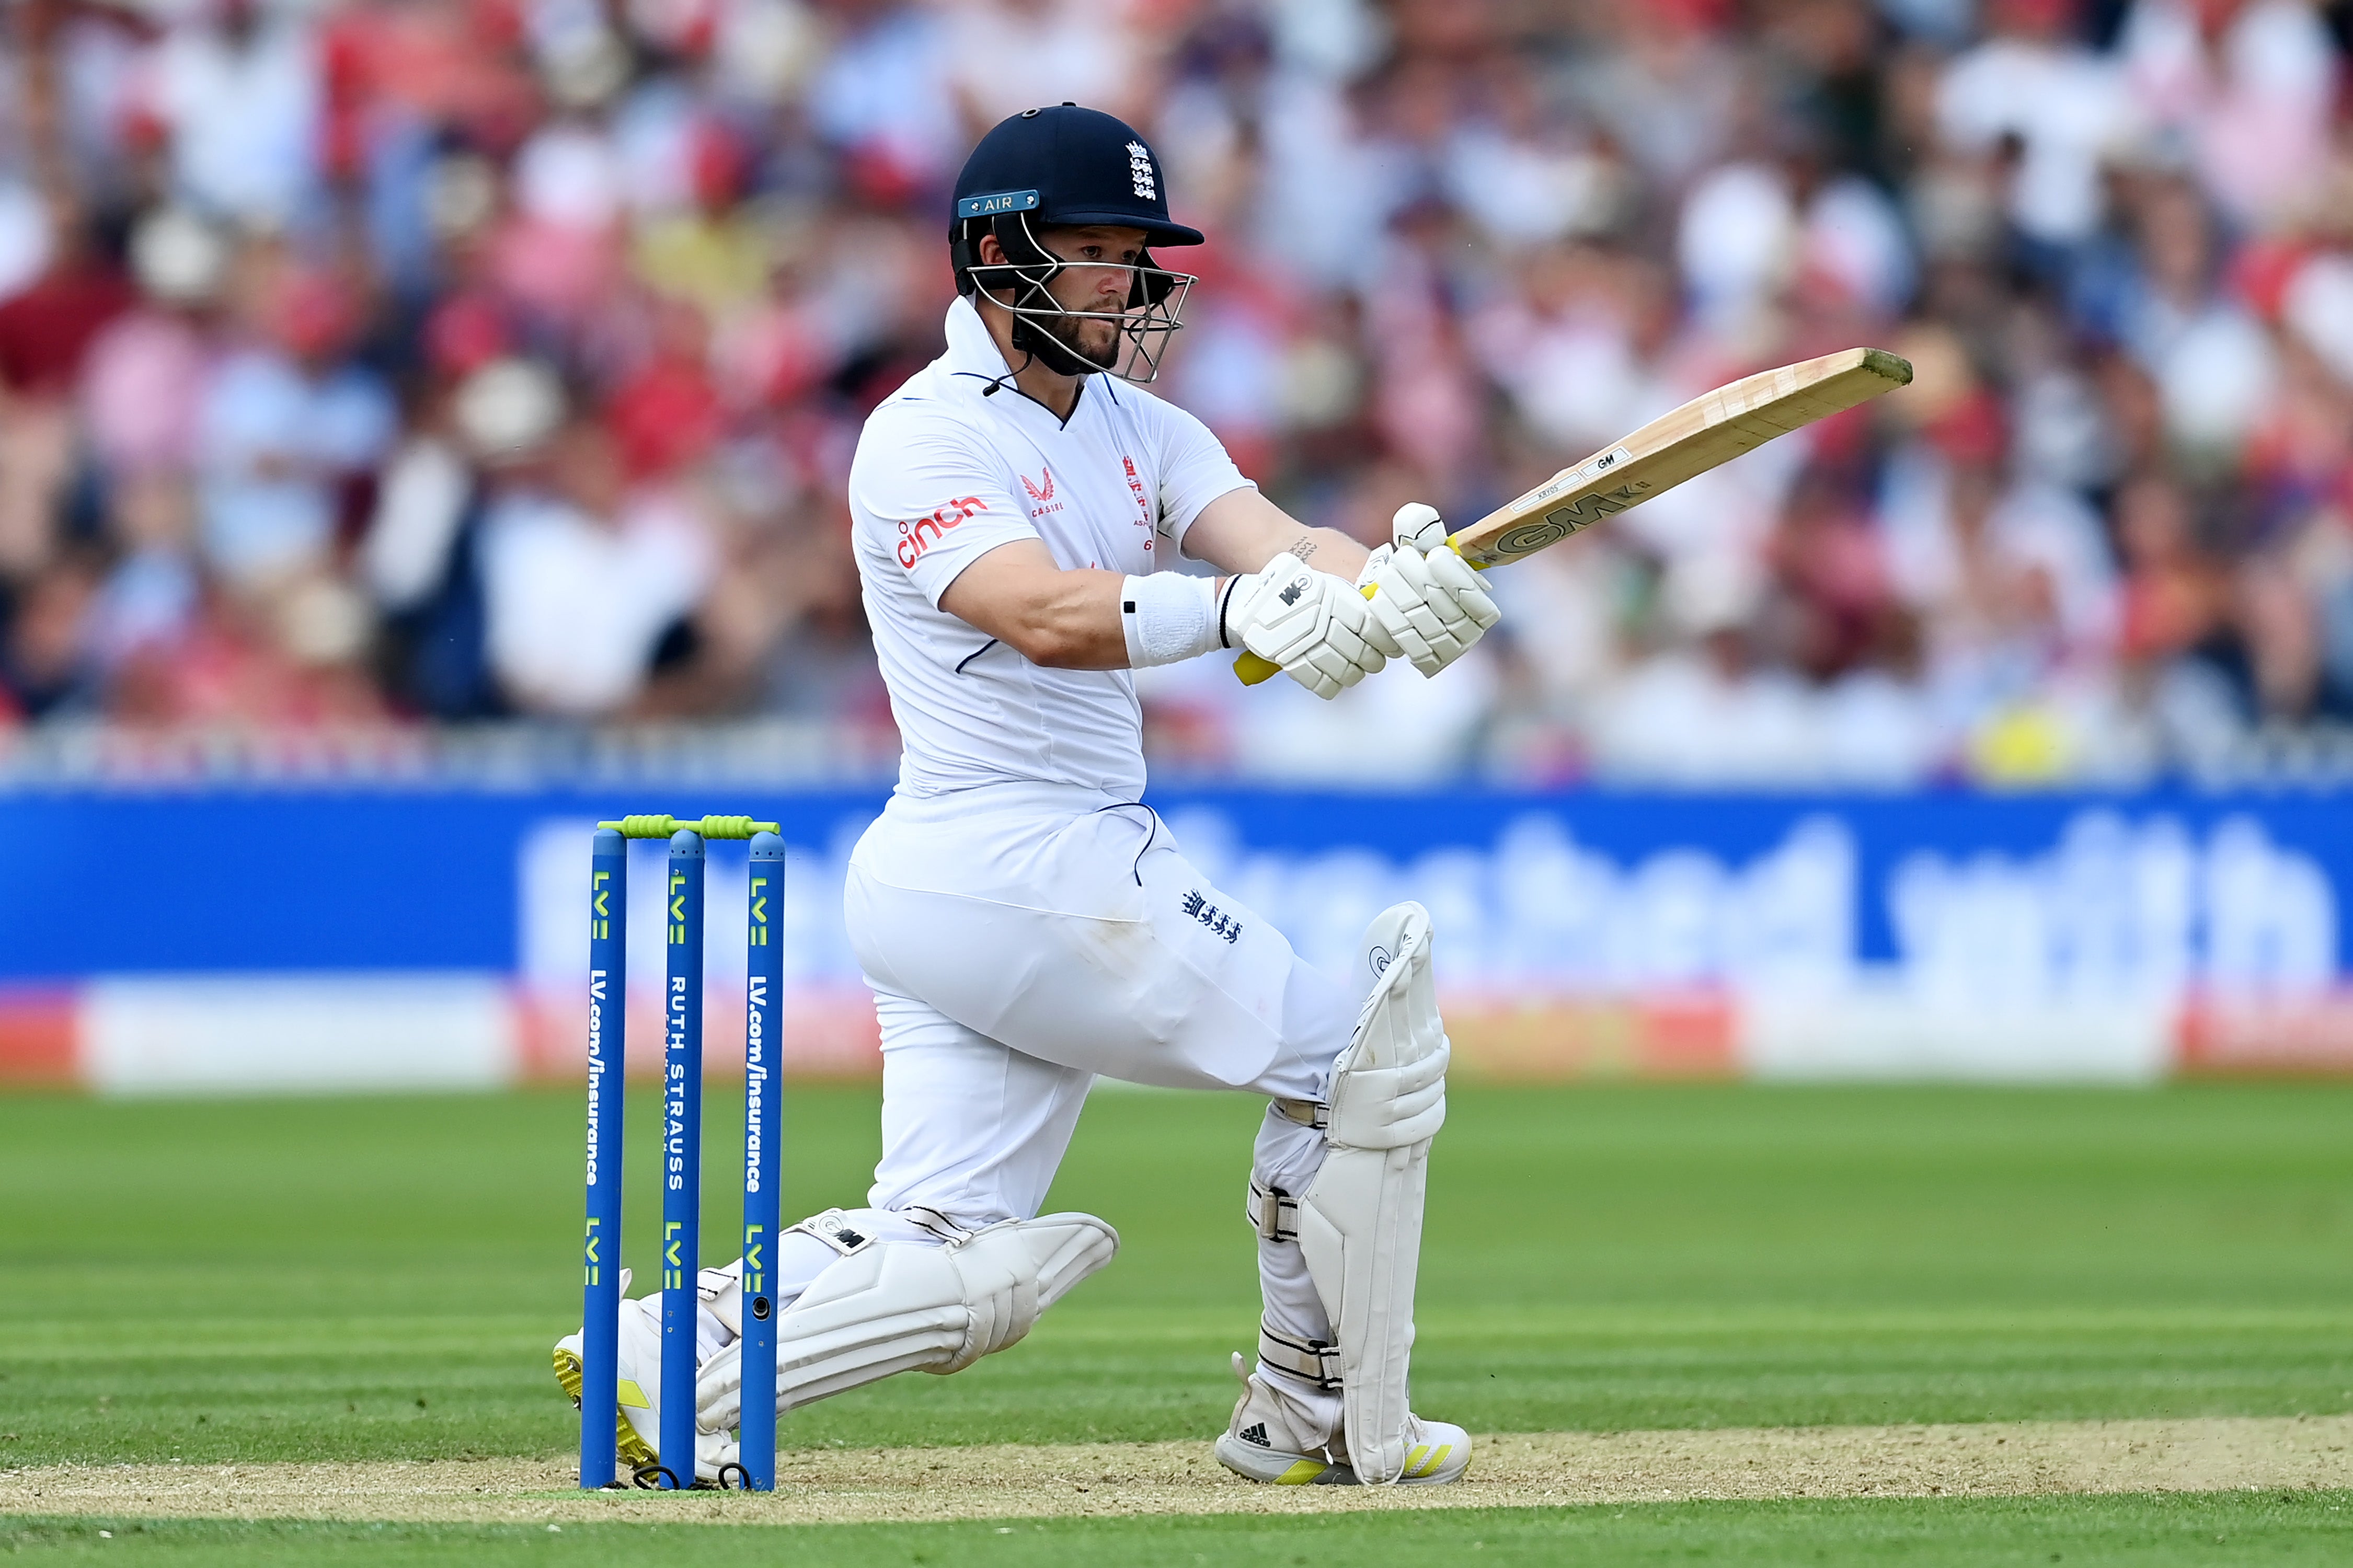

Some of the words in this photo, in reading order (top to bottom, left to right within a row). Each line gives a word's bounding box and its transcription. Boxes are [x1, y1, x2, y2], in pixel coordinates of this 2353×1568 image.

[984, 197, 1012, 212] AIR
[1598, 454, 1615, 469] GM
[1537, 483, 1558, 500] KRYOS
[898, 497, 988, 569] cinch
[1497, 493, 1626, 554] GM
[1279, 573, 1313, 606] GM
[671, 976, 686, 1050] RUTH
[586, 970, 606, 1186] LV.com/insurance
[746, 976, 767, 1193] LV.com/insurance
[669, 1064, 685, 1191] STRAUSS
[819, 1215, 865, 1249] GM
[1239, 1432, 1271, 1447] adidas
